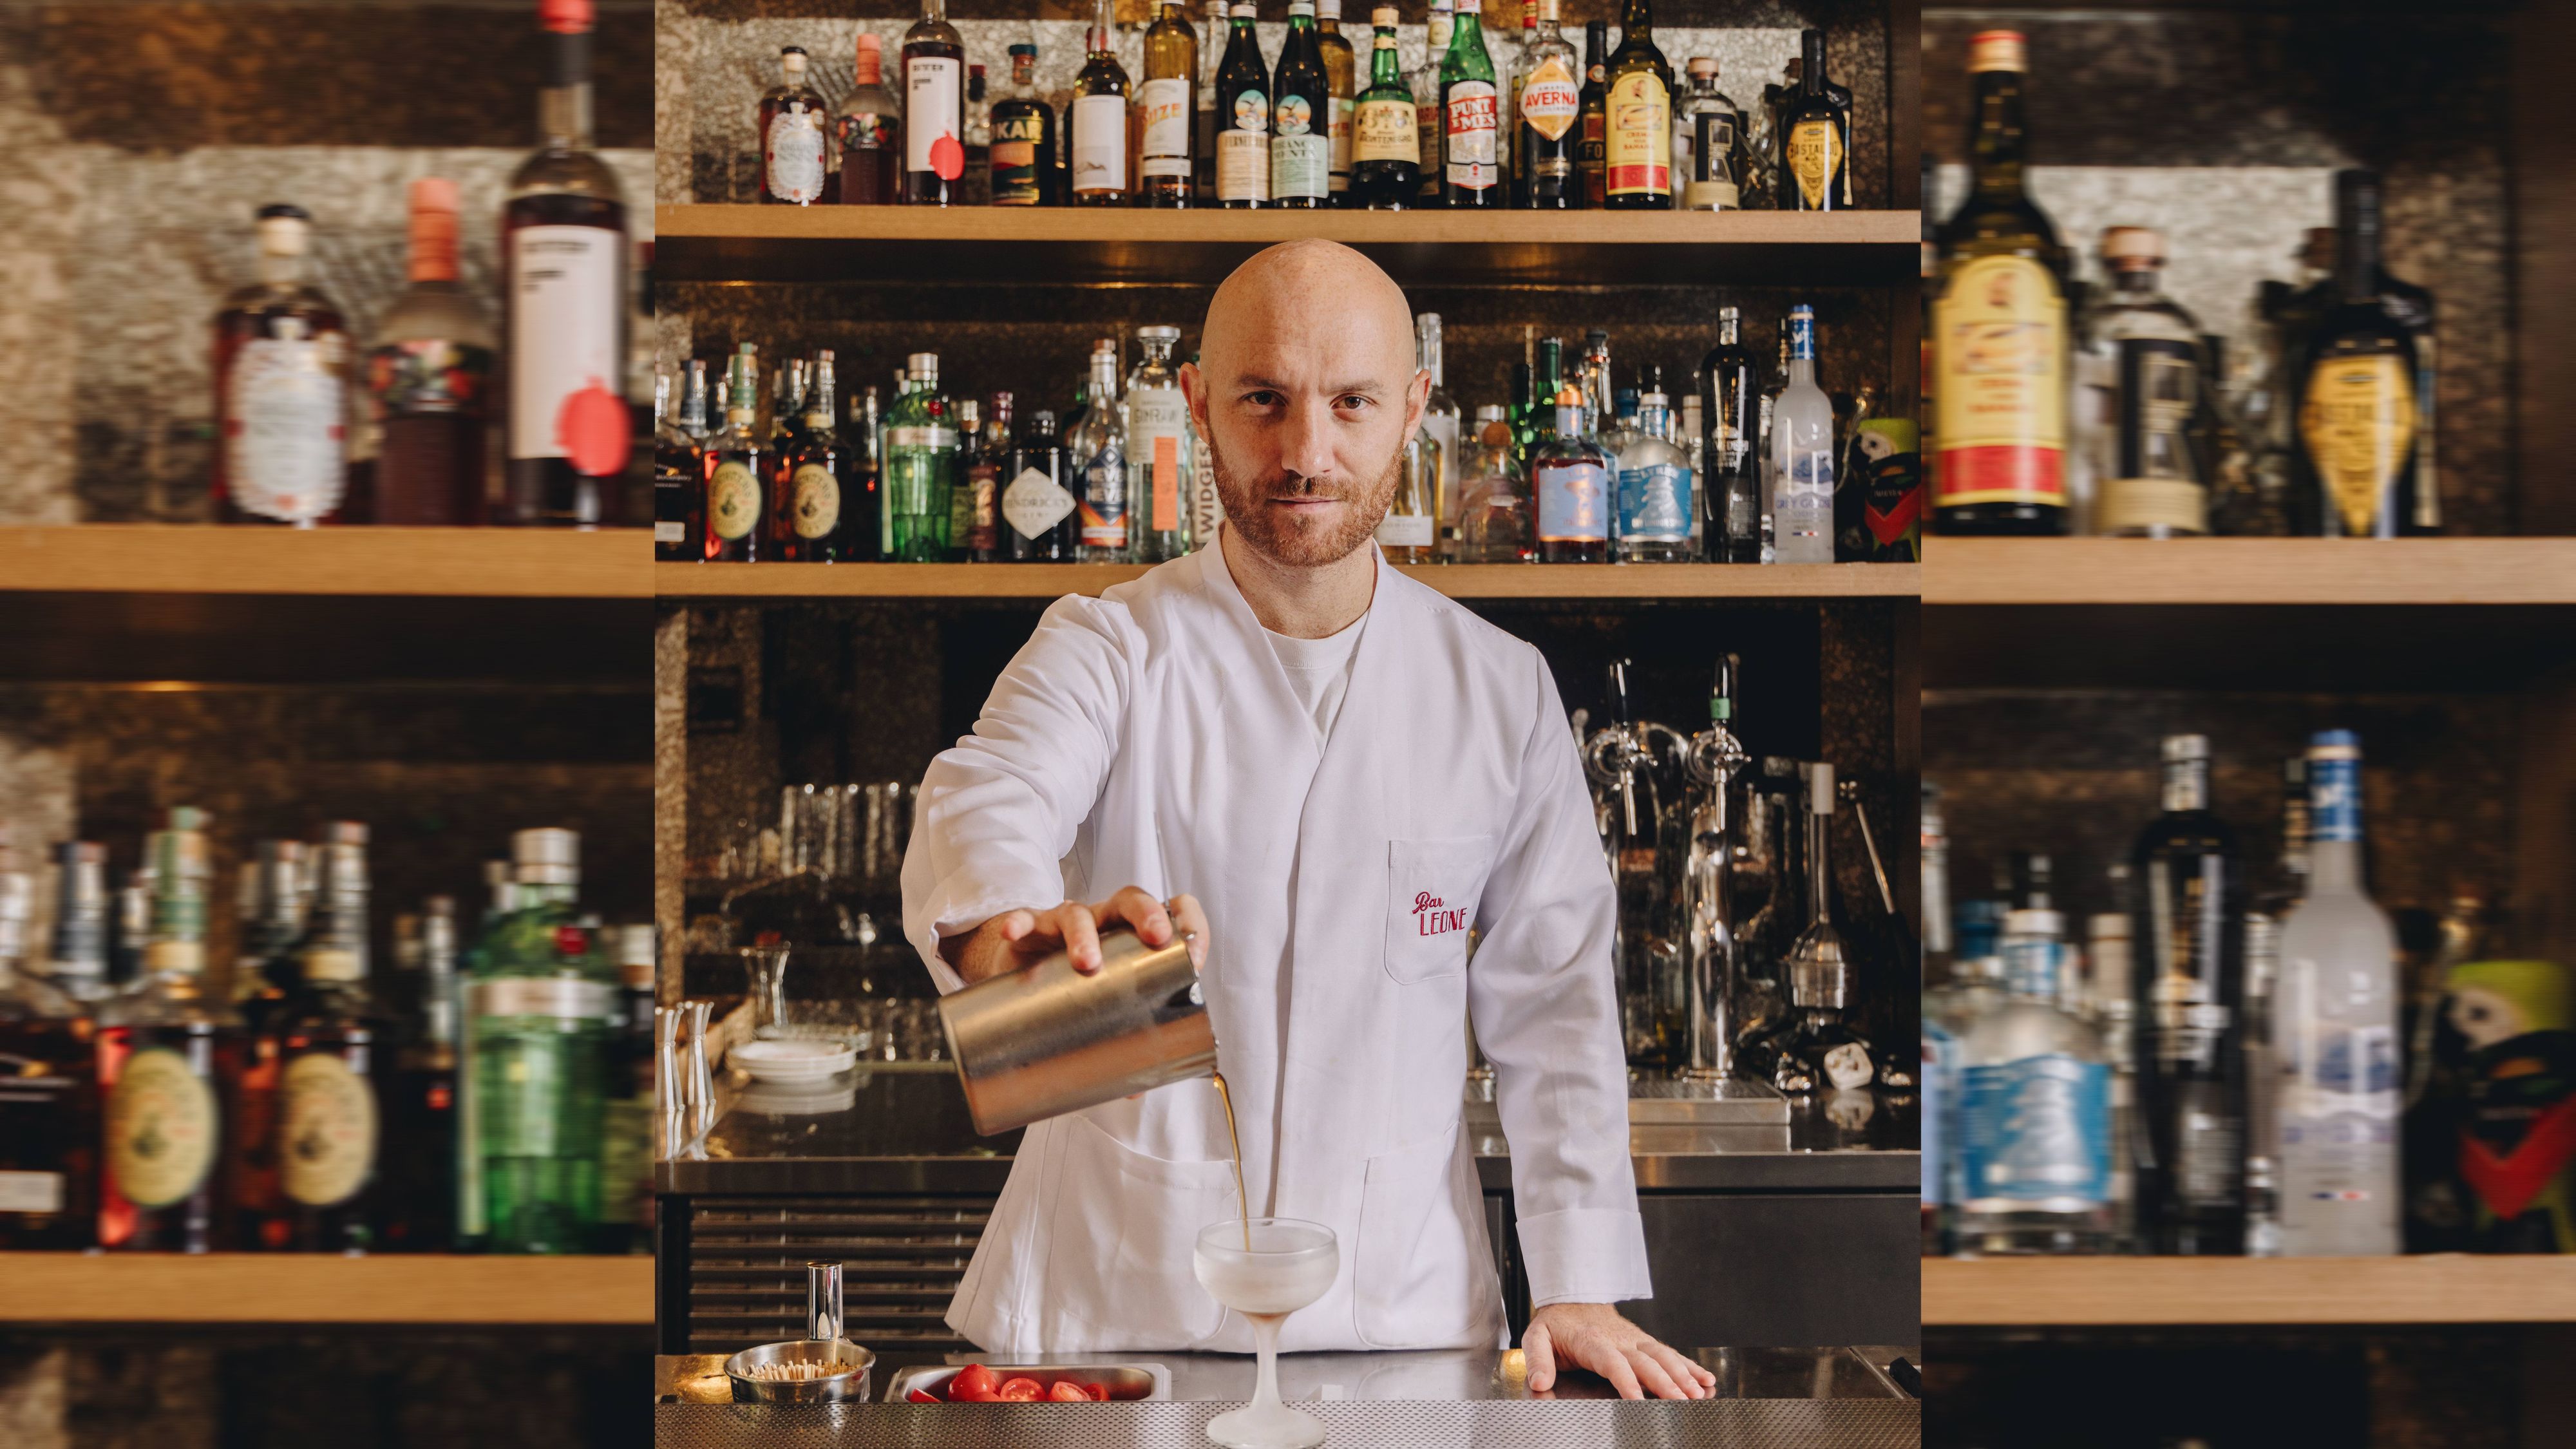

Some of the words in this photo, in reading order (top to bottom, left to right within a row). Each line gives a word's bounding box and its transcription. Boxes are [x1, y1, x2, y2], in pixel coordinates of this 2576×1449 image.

[1449, 98, 1491, 118] PUNT
[1524, 92, 1577, 109] AVERNA
[1460, 113, 1496, 129] MES
[1412, 891, 1444, 914] Bar
[1420, 907, 1468, 936] LEONE
